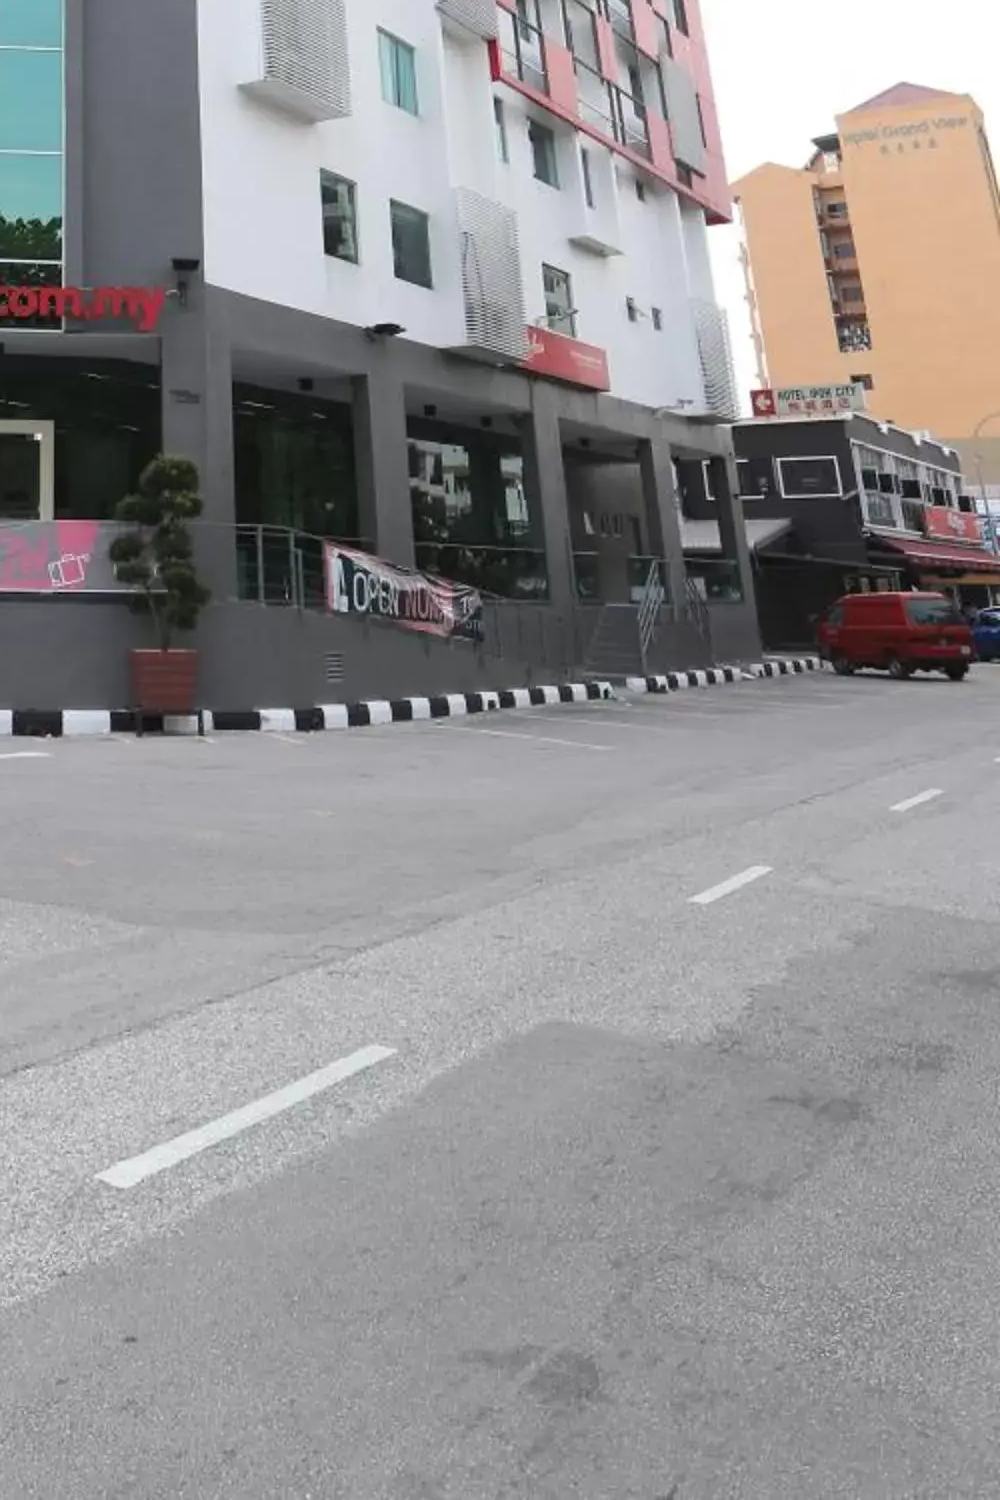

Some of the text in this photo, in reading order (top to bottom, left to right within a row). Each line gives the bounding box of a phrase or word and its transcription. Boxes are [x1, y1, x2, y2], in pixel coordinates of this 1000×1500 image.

[778, 389, 805, 400] HOTEL
[835, 386, 856, 397] CITY
[353, 571, 399, 617] OPEN
